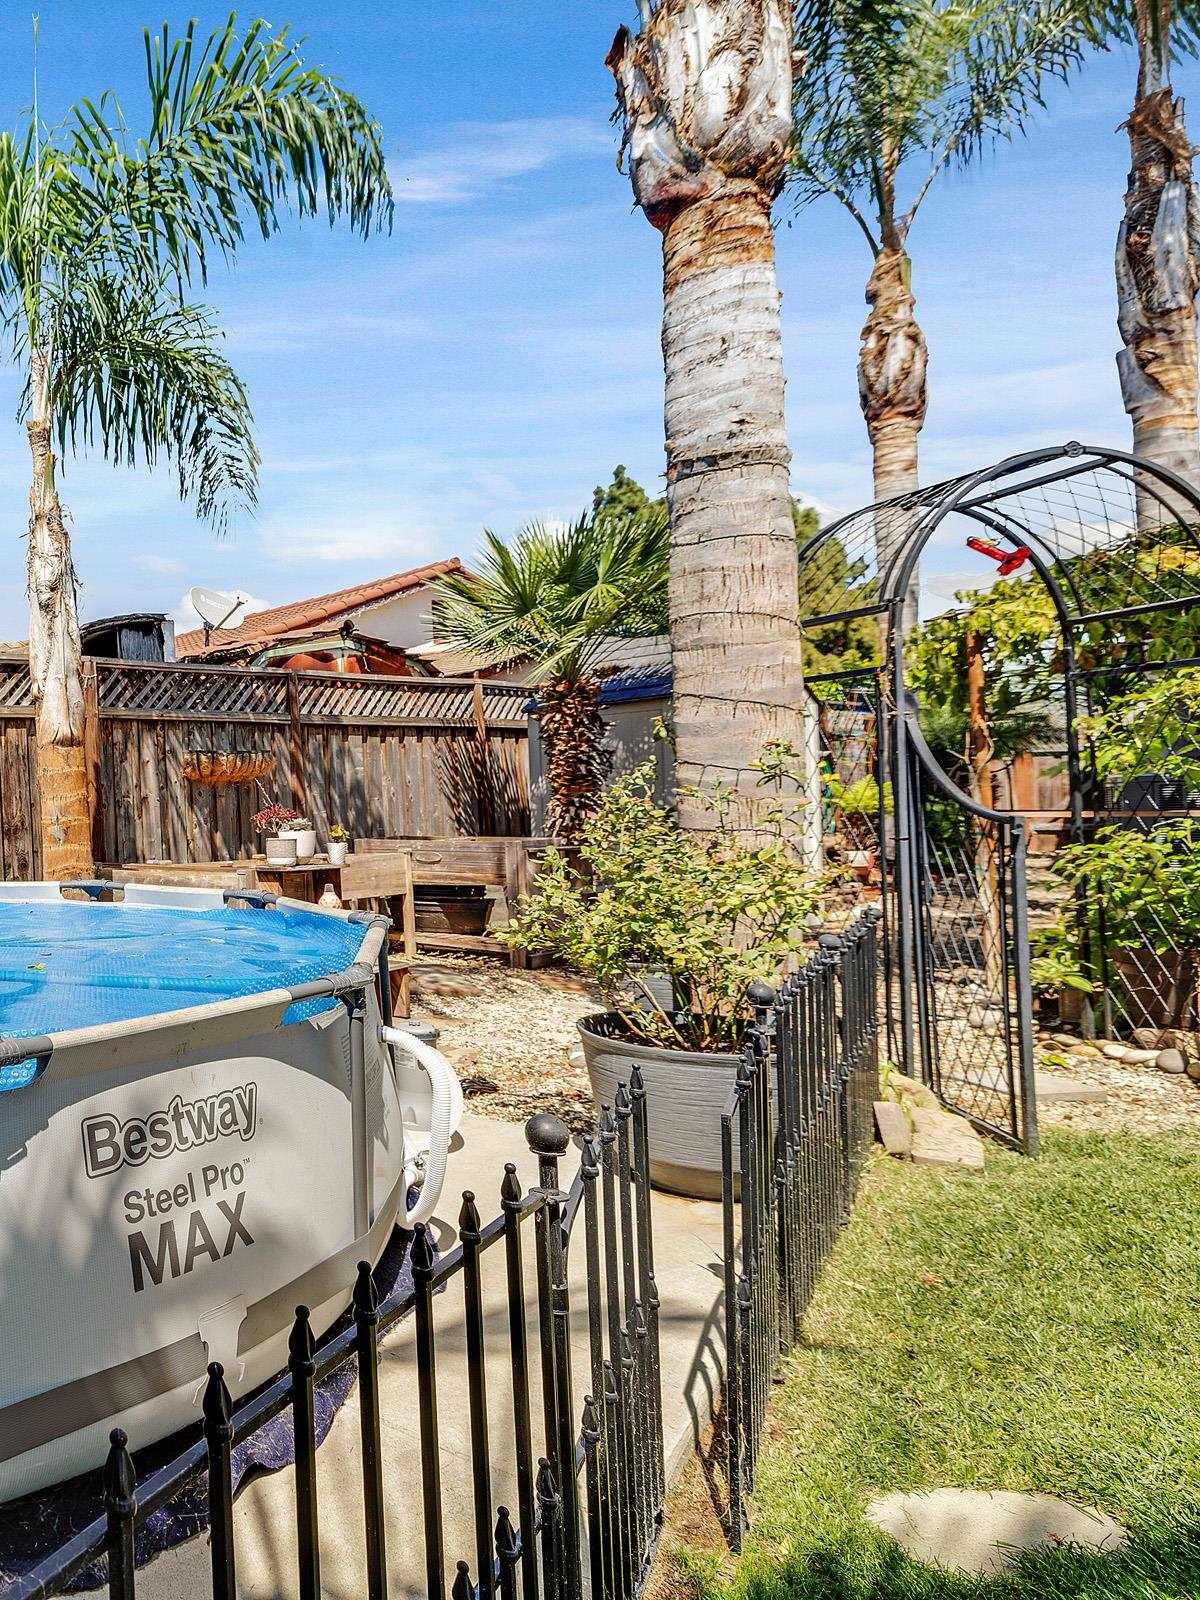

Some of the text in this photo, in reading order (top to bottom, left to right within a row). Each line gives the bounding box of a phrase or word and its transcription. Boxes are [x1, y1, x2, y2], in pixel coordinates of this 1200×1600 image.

[83, 1084, 256, 1176] Bestway
[124, 1172, 196, 1224] Steel
[127, 1191, 255, 1293] MAX
